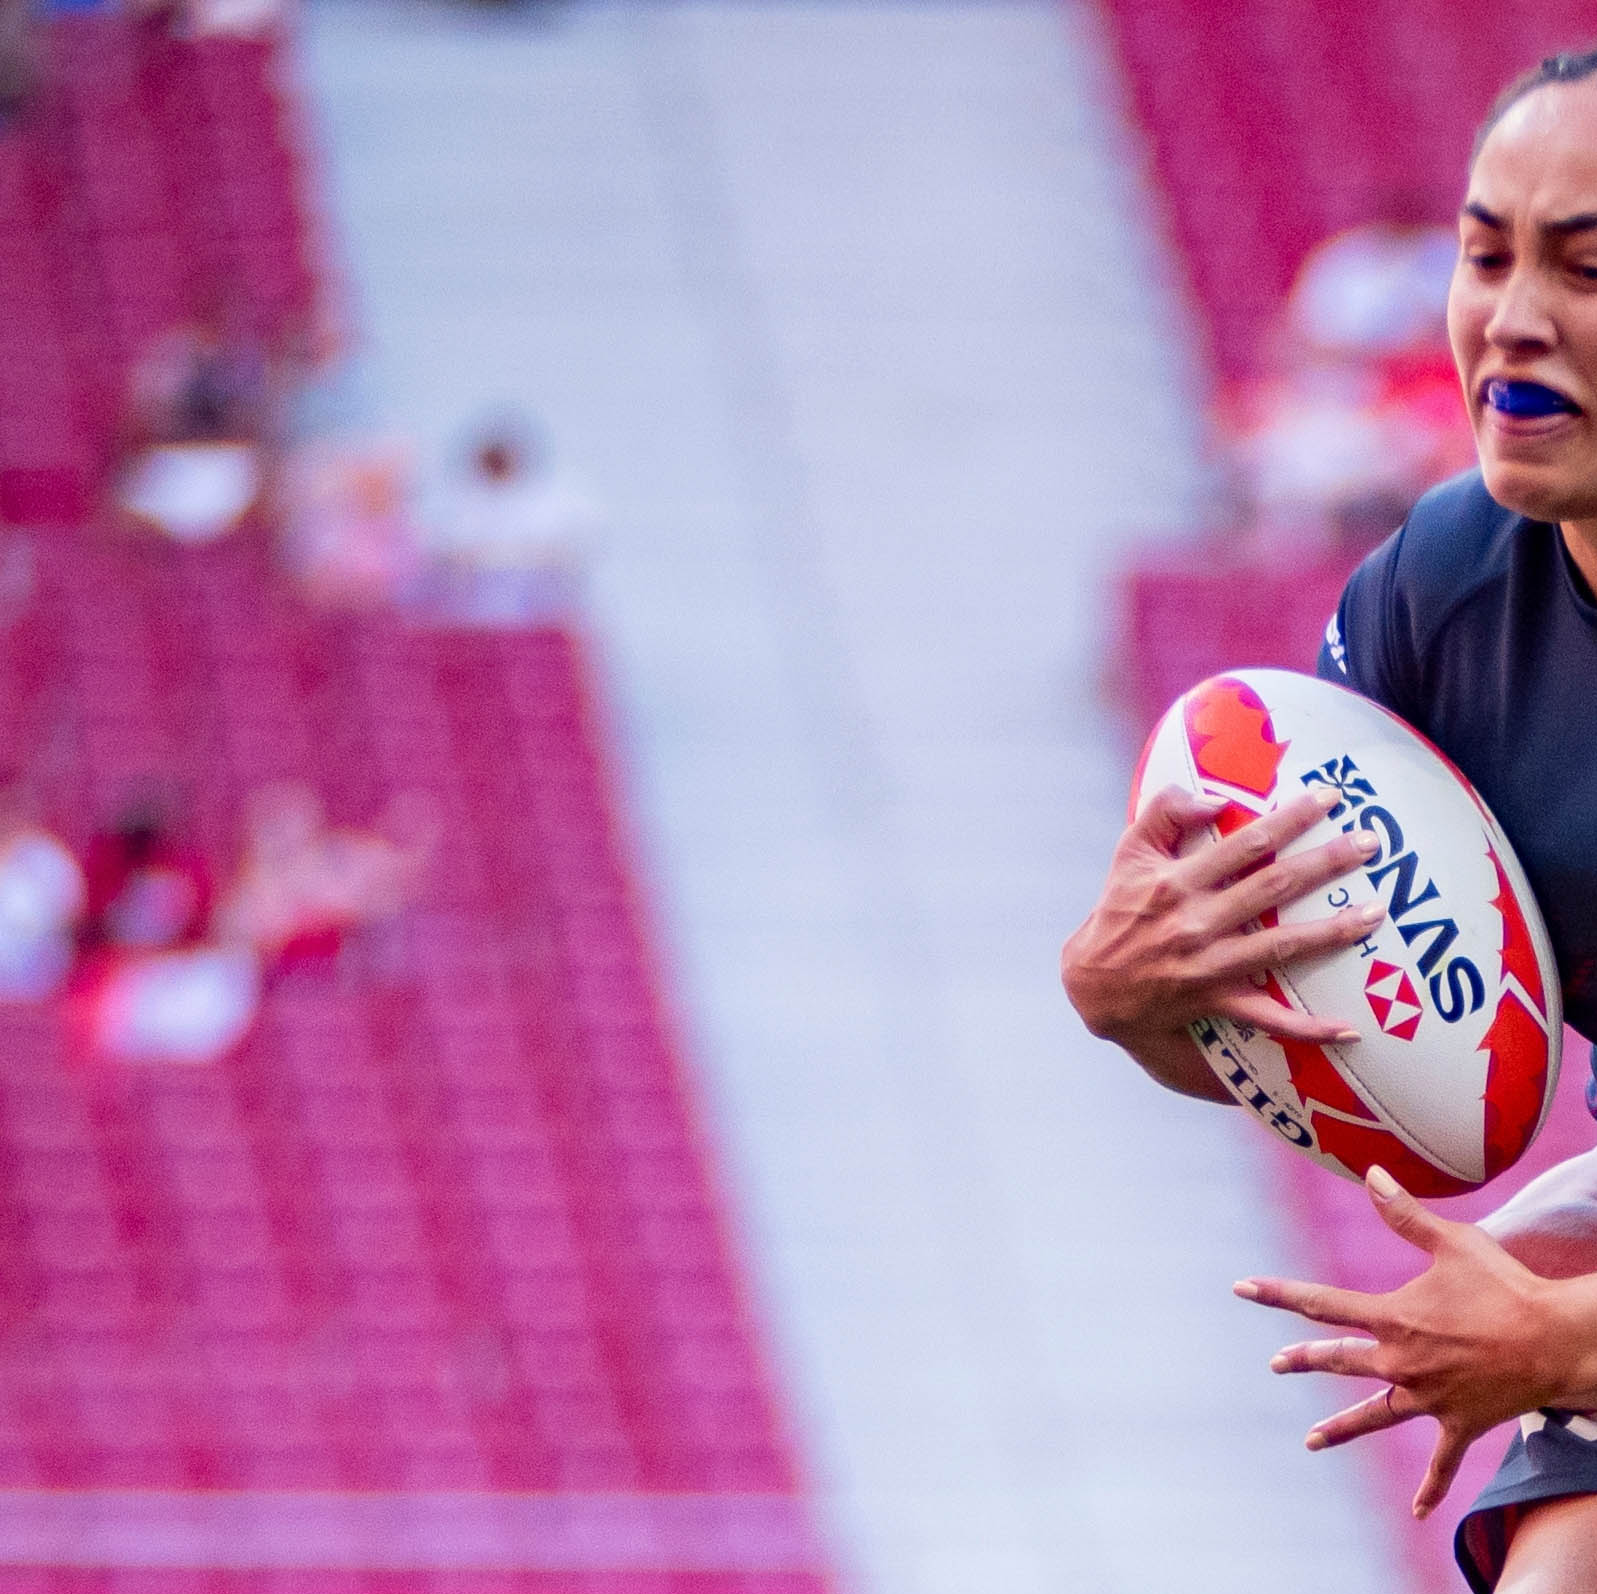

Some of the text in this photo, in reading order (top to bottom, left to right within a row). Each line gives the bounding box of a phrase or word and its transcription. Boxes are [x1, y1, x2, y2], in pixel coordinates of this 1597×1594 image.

[1328, 887, 1378, 957] HC
[1342, 805, 1485, 1023] SVNS
[1190, 1018, 1313, 1148] GILB
